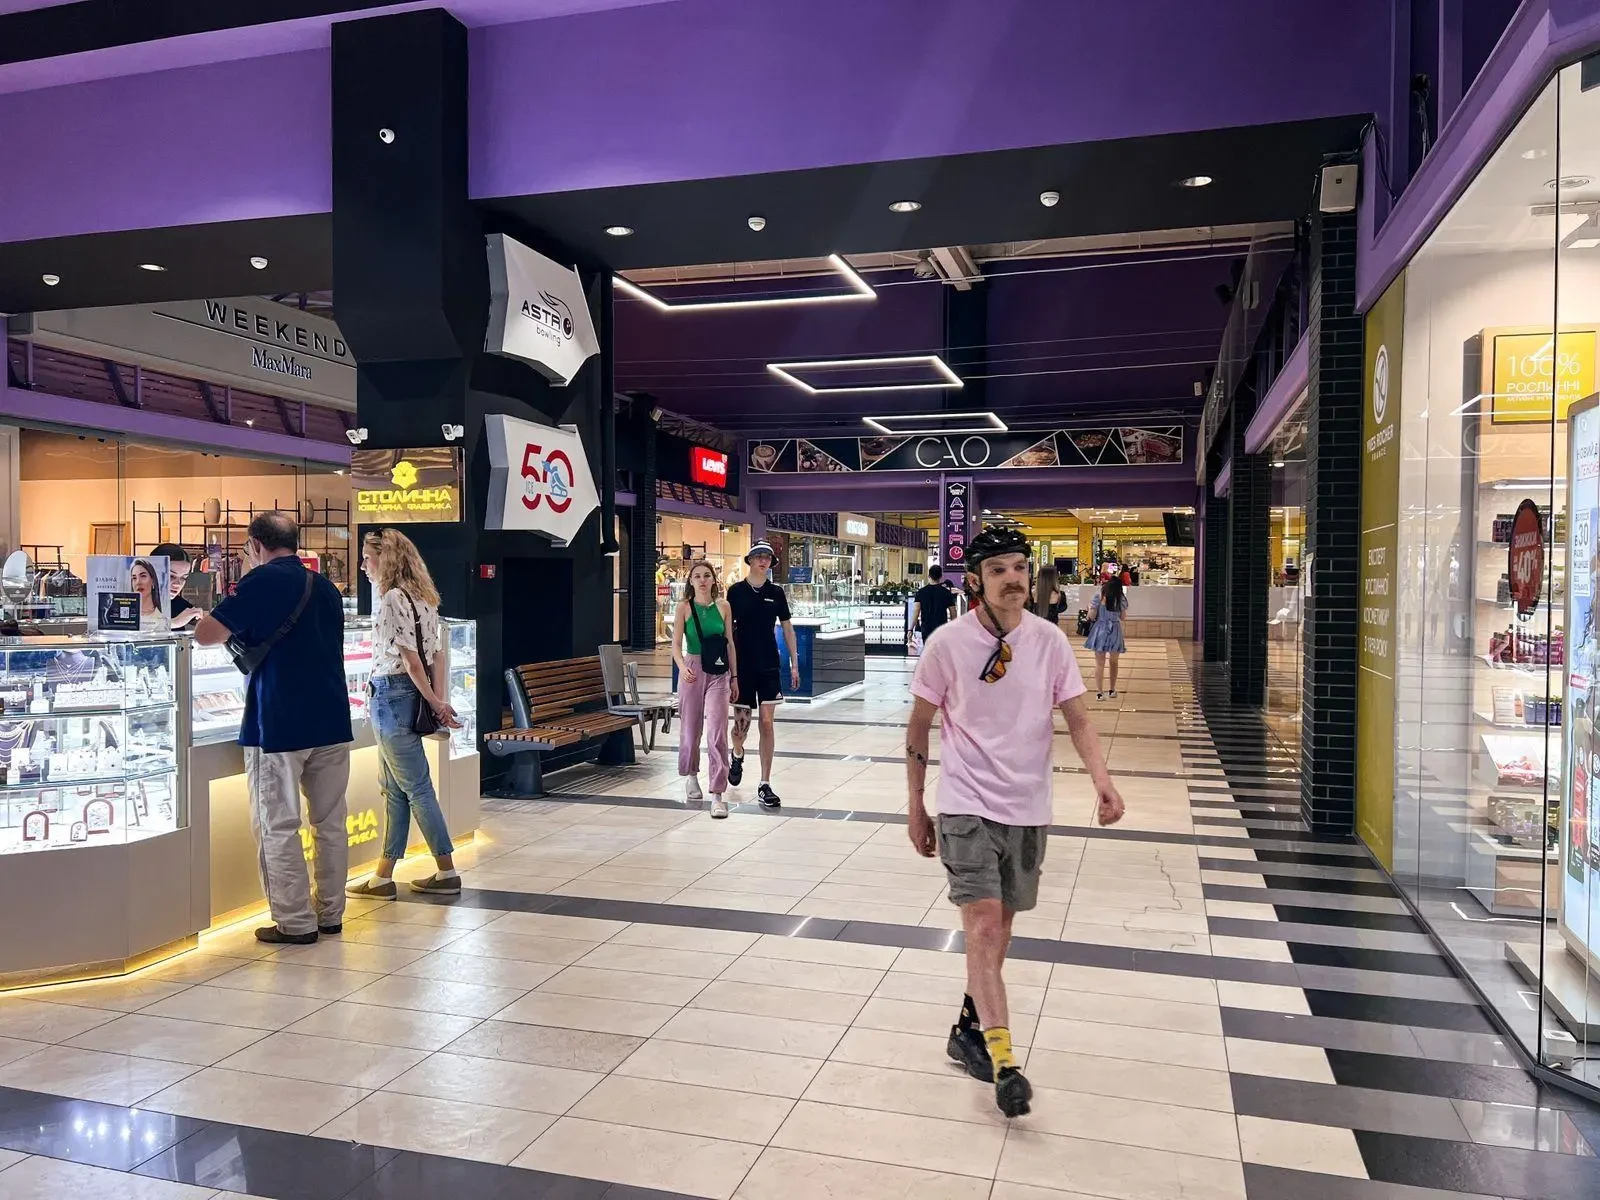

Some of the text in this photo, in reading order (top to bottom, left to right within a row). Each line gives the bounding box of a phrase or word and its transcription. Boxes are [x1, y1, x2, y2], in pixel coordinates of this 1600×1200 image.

[204, 299, 347, 357] WEEKEND
[536, 326, 561, 347] bowling
[251, 347, 312, 381] MaxMara
[1507, 353, 1580, 377] 100%
[915, 435, 990, 468] CAO
[520, 443, 575, 514] 50
[357, 489, 451, 504] СТОЛИЧНА
[1578, 522, 1590, 546] 30
